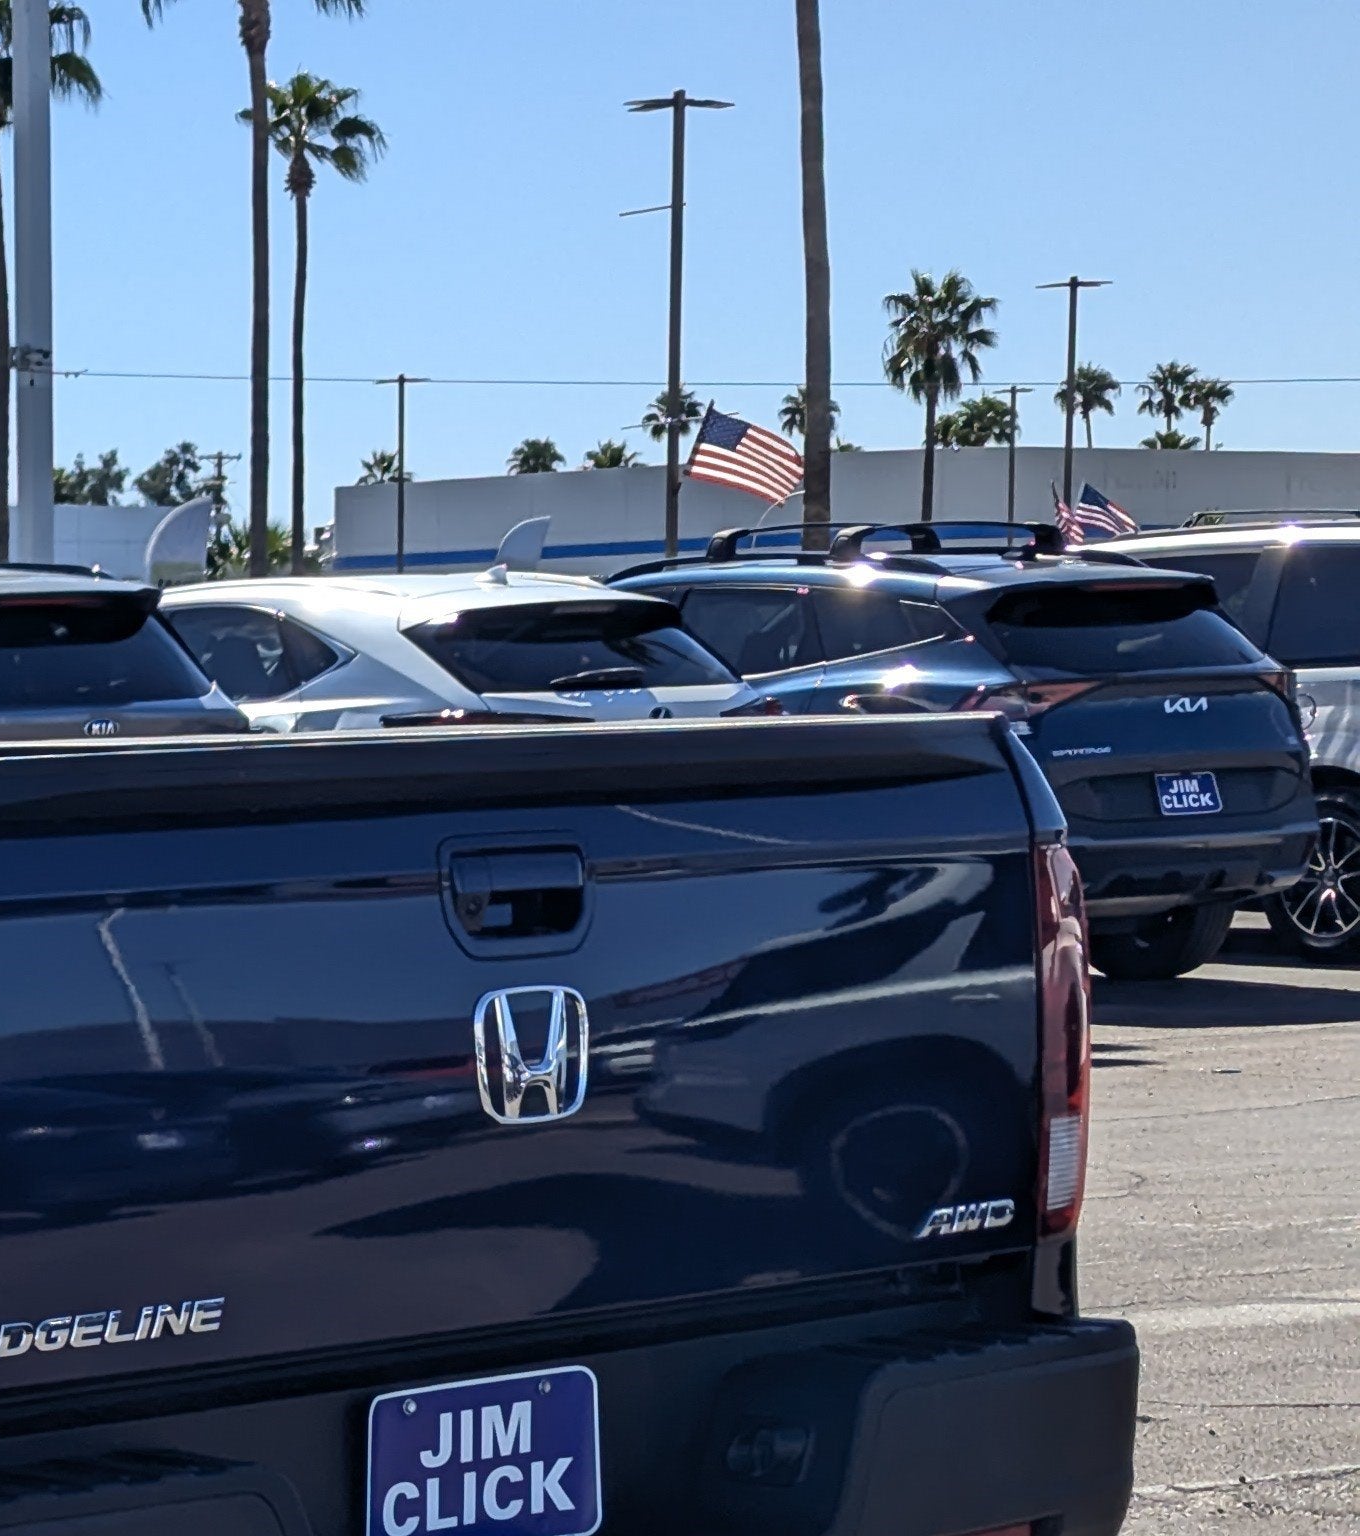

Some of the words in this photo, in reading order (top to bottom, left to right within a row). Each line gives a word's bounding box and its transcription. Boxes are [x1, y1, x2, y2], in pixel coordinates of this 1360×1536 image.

[1169, 779, 1199, 793] JIM
[1162, 793, 1213, 808] CLICK
[915, 1199, 1014, 1239] AWD
[419, 1400, 532, 1468] JIM
